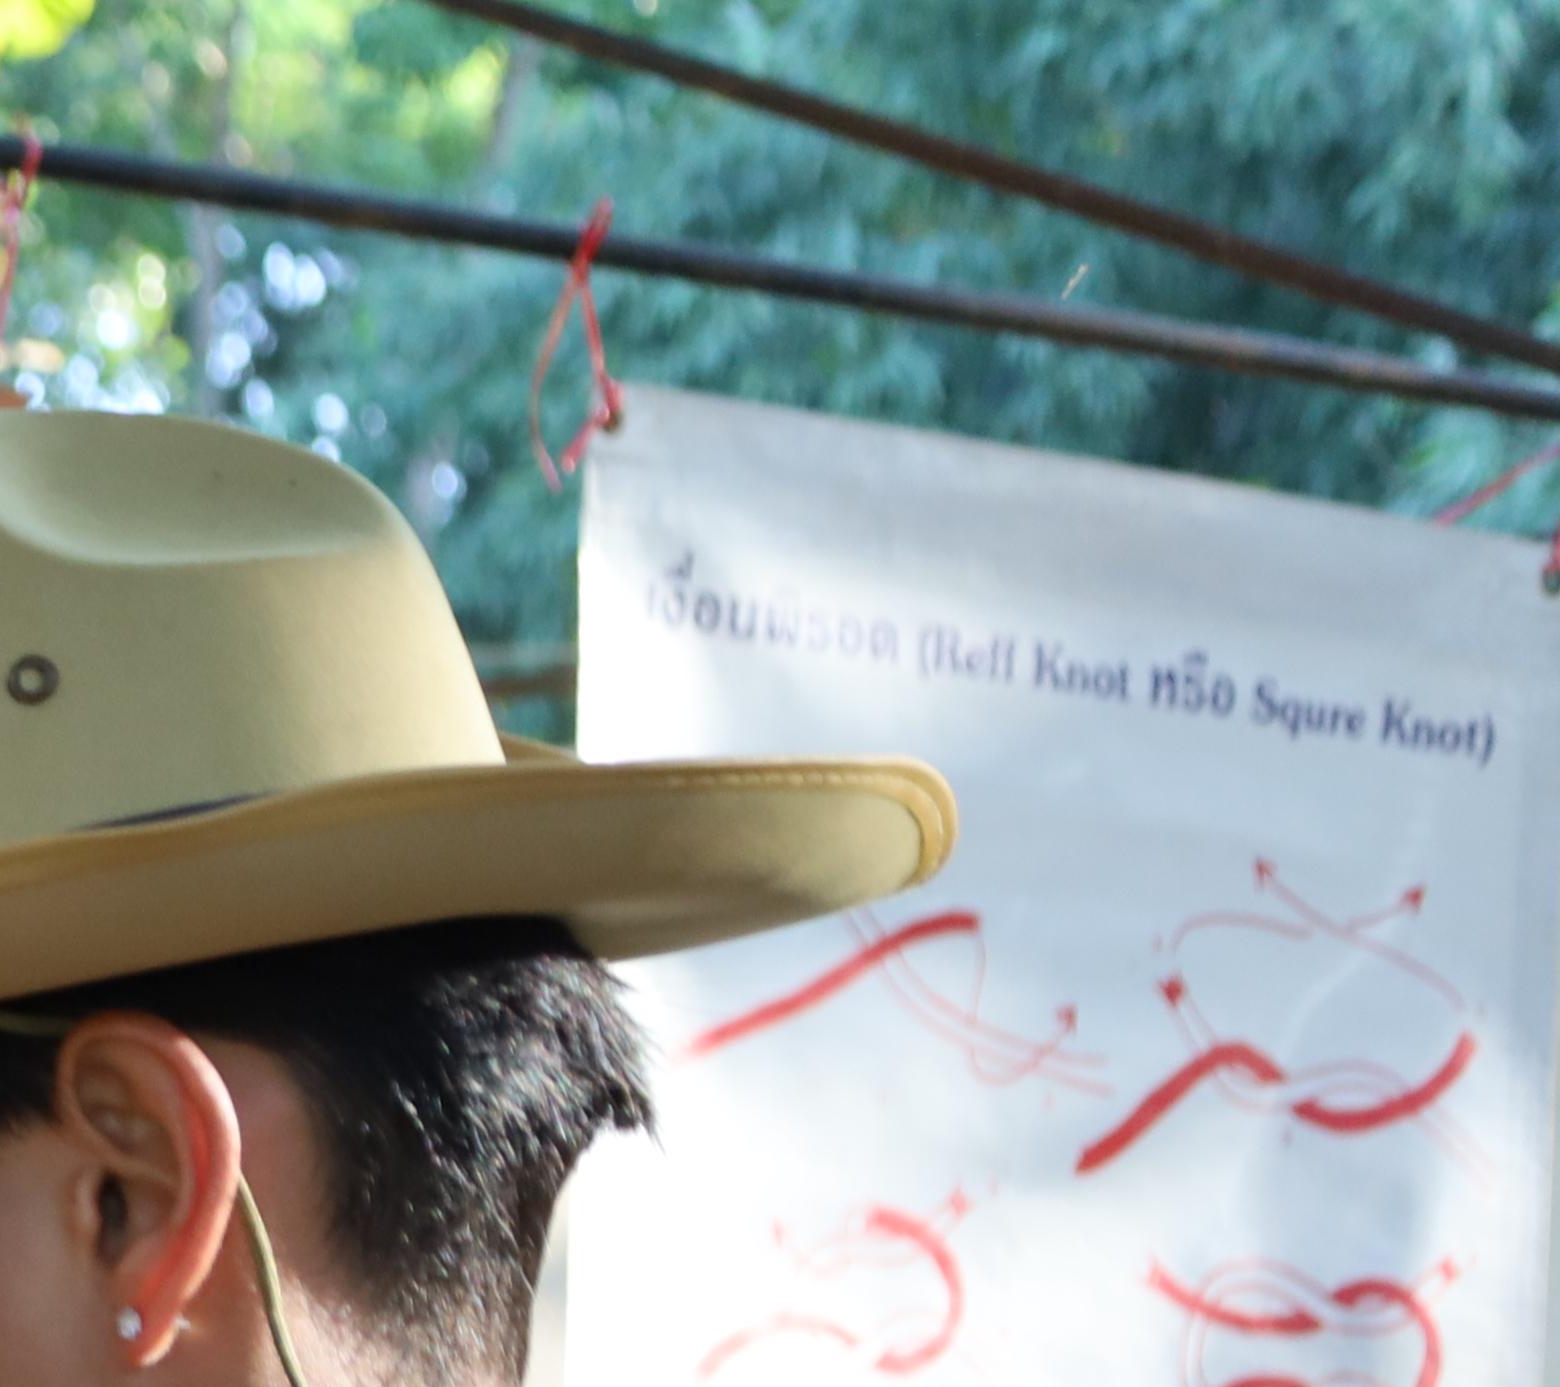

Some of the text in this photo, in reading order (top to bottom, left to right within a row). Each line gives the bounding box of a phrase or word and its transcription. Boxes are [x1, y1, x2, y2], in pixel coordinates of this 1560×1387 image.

[1033, 640, 1132, 704] Knot
[1250, 677, 1367, 740] Squre
[1379, 694, 1498, 770] Knot)
